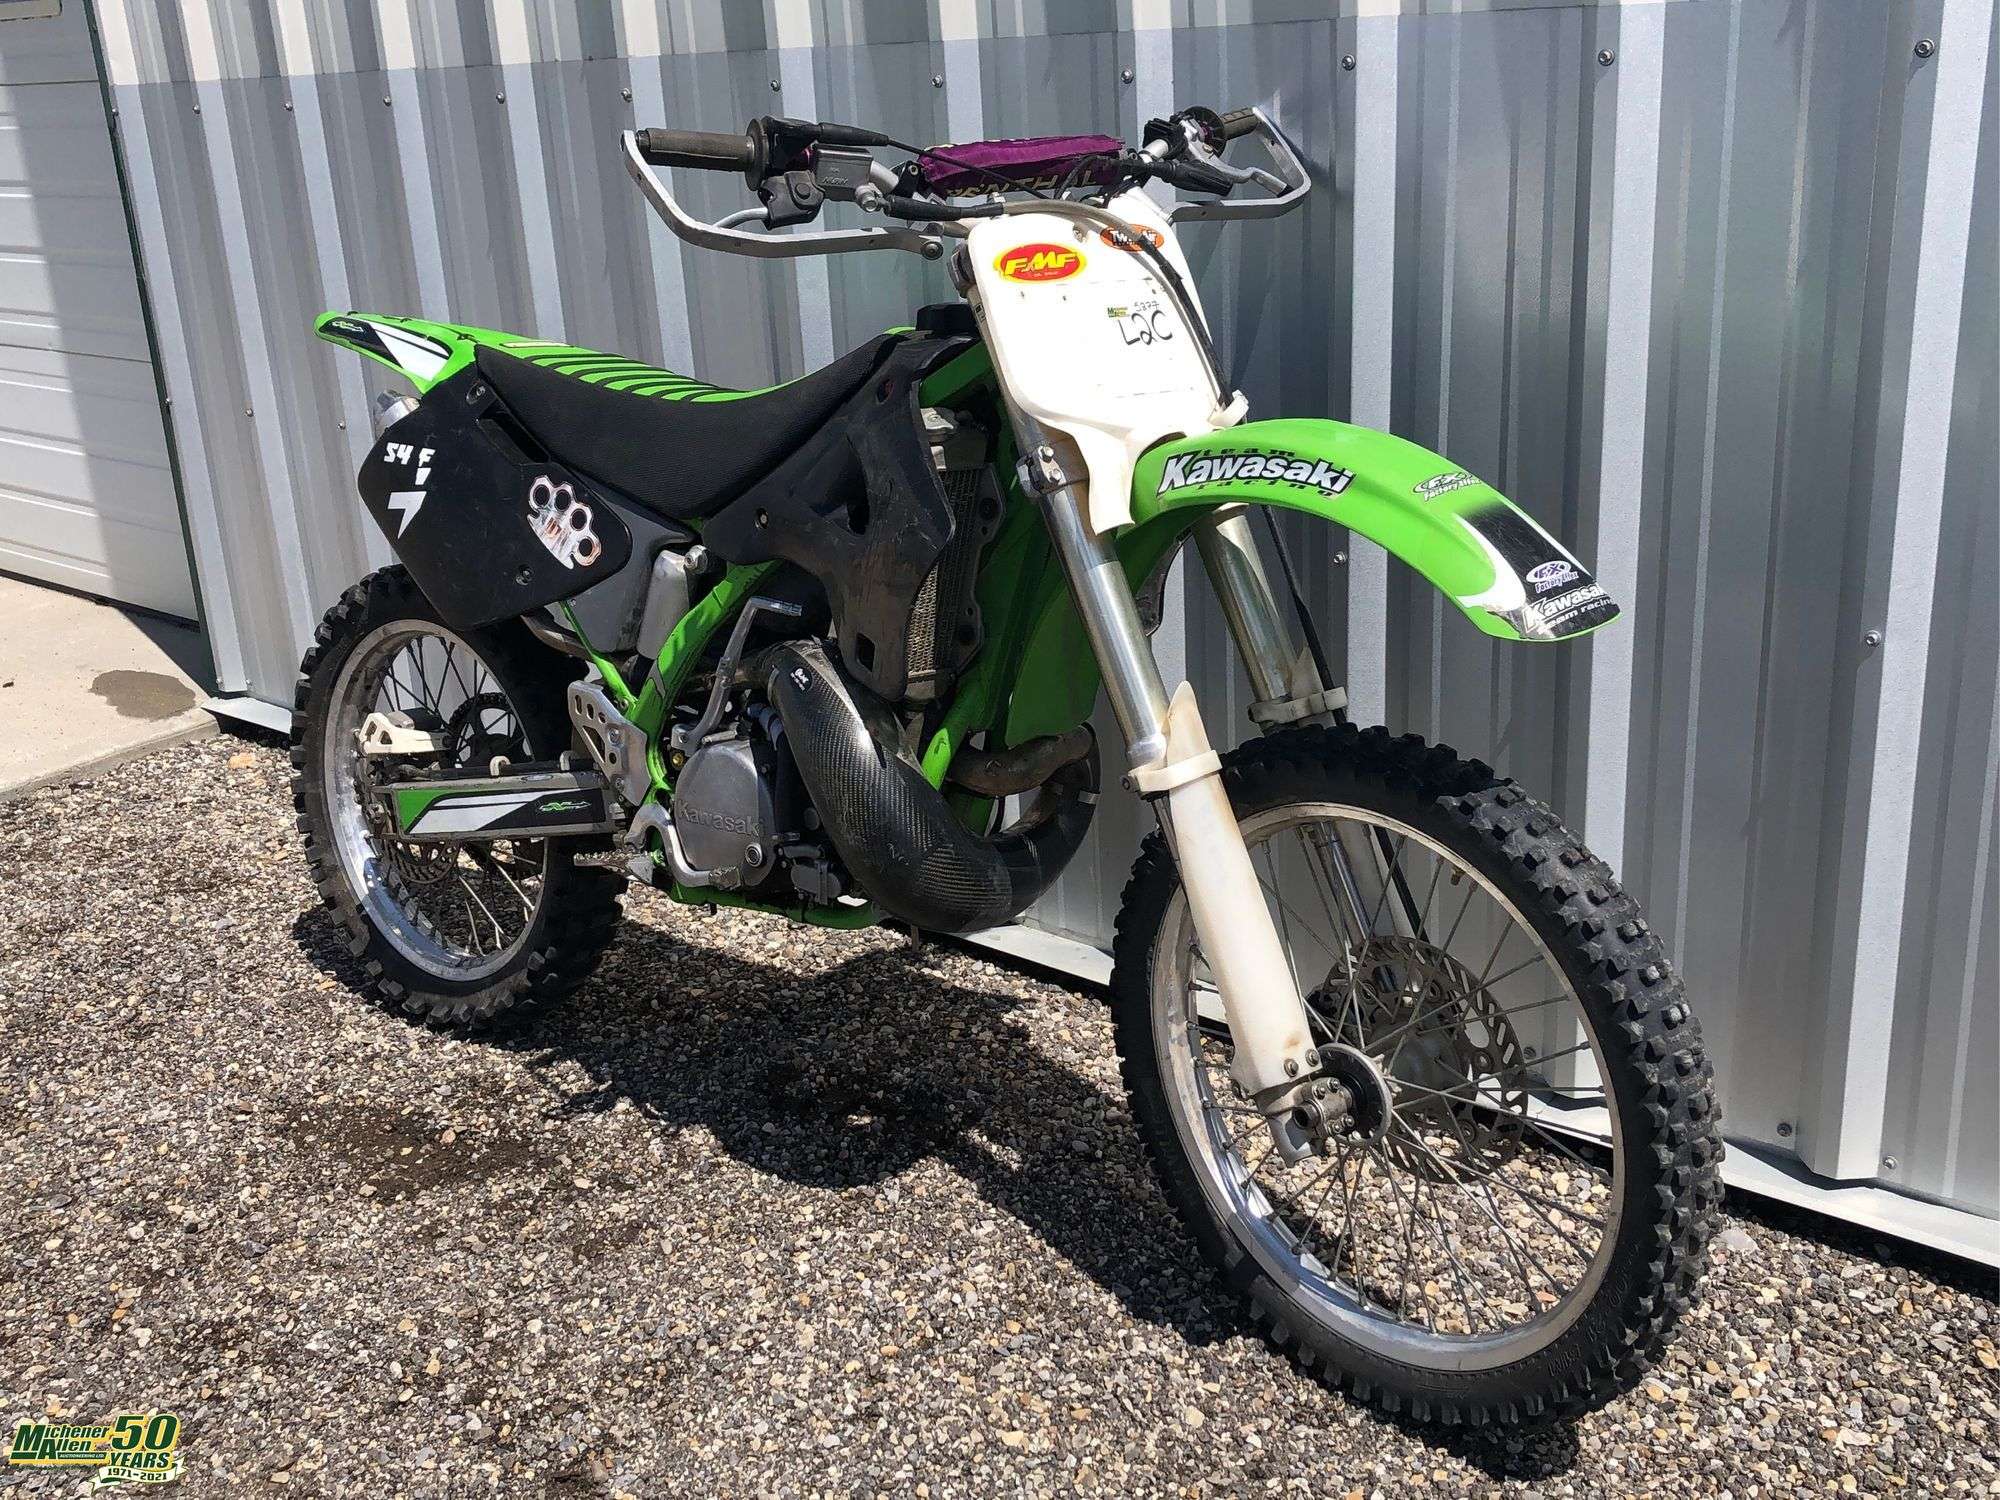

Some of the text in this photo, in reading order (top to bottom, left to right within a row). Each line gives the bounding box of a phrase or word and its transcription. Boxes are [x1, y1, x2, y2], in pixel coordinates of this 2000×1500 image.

[1003, 250, 1078, 276] FMF
[1156, 451, 1357, 498] Kawasaki
[1522, 582, 1609, 634] Kawasa
[679, 799, 762, 838] Kawasak
